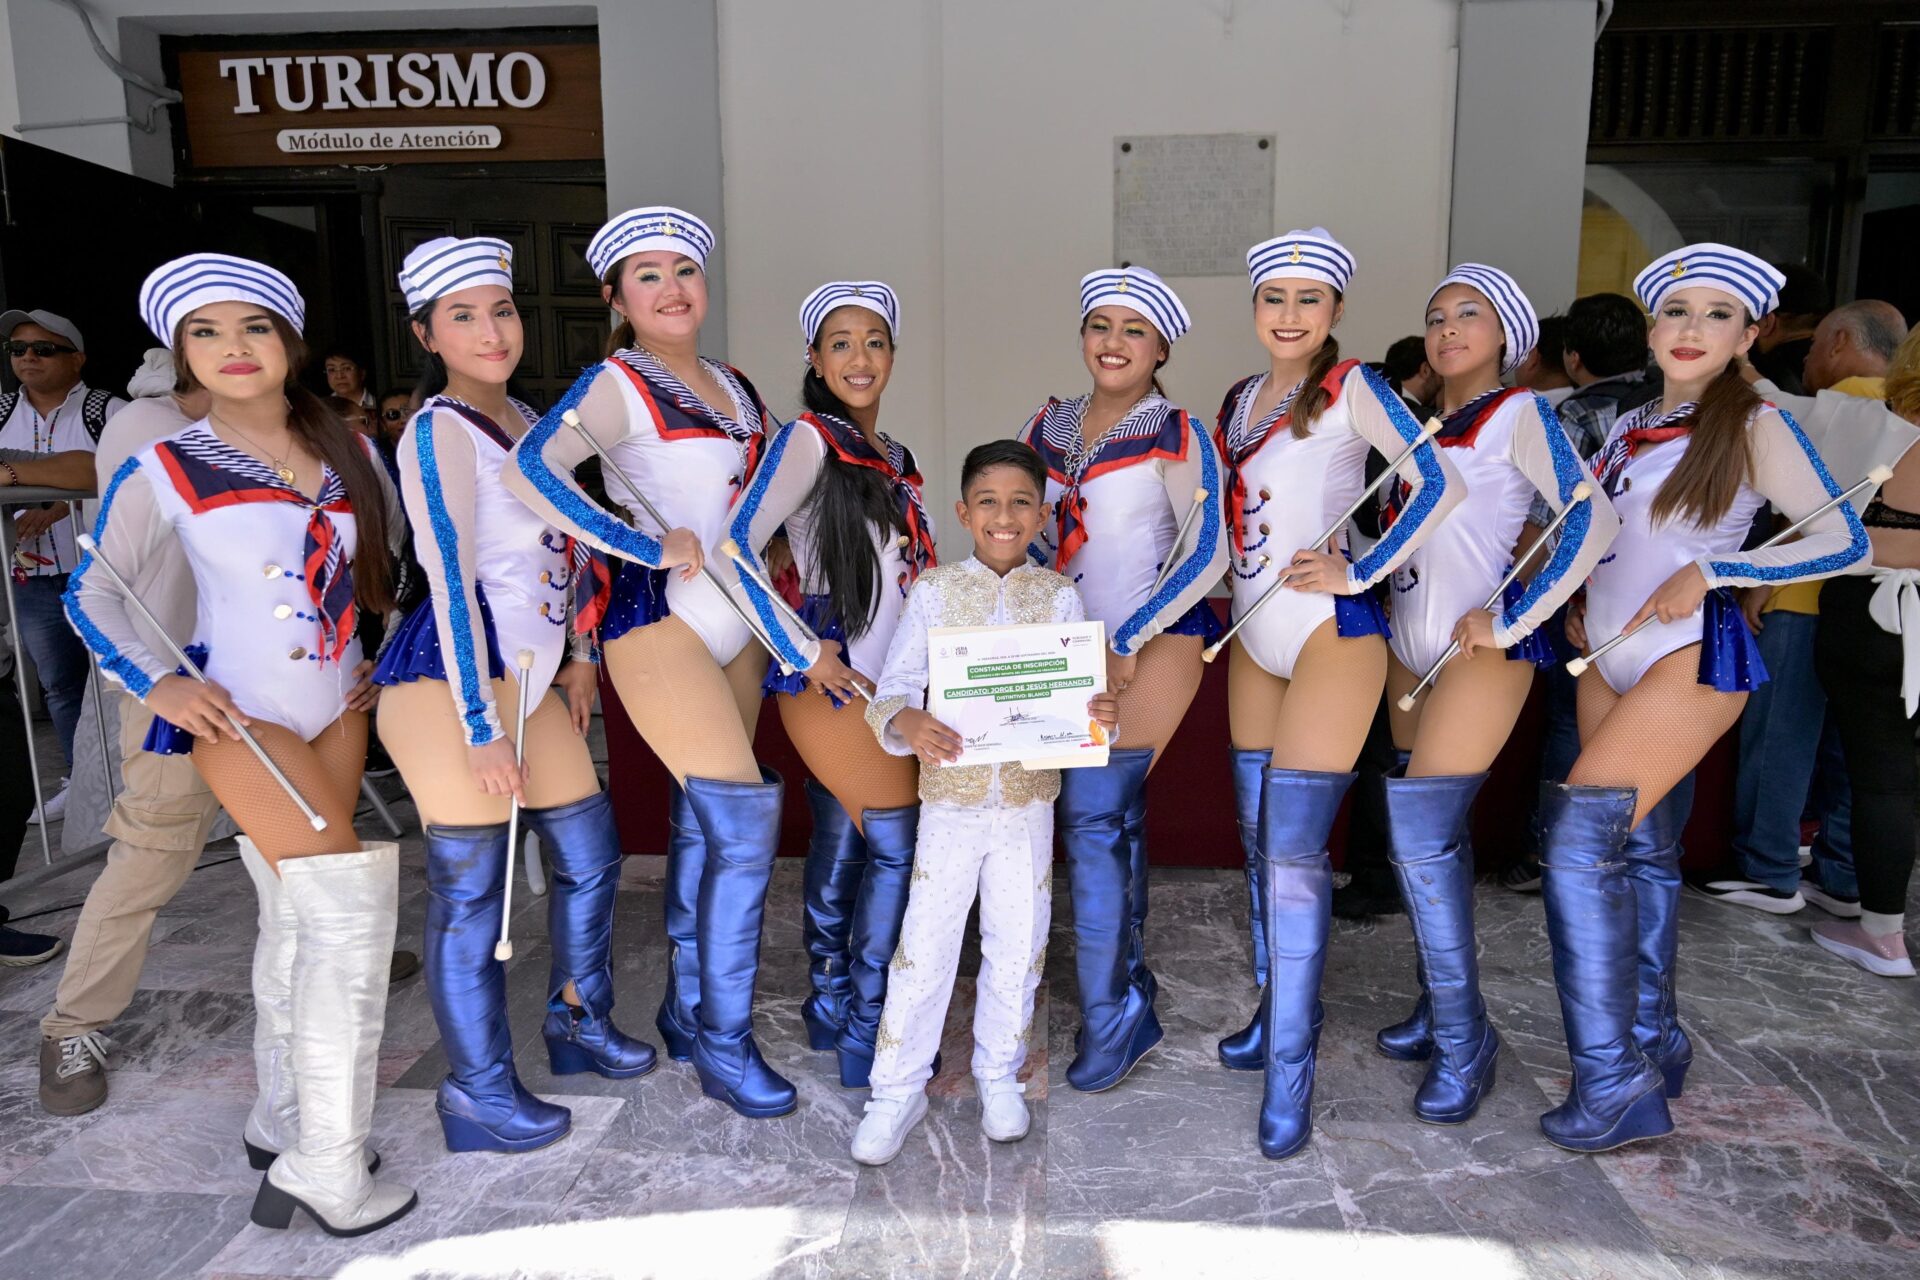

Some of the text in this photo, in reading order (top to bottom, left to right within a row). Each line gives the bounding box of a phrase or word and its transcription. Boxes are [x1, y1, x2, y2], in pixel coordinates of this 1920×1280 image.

[219, 51, 546, 114] TURISMO
[288, 130, 491, 151] Módulo de Atención
[969, 665, 1012, 674] CONSTANCIA
[1023, 659, 1065, 669] INSCRIPCIÓN
[946, 678, 1093, 698] CANDIDATO: JORGE DE JESÚS HERNANDEZ
[996, 693, 1027, 701] DISTINTIVO:
